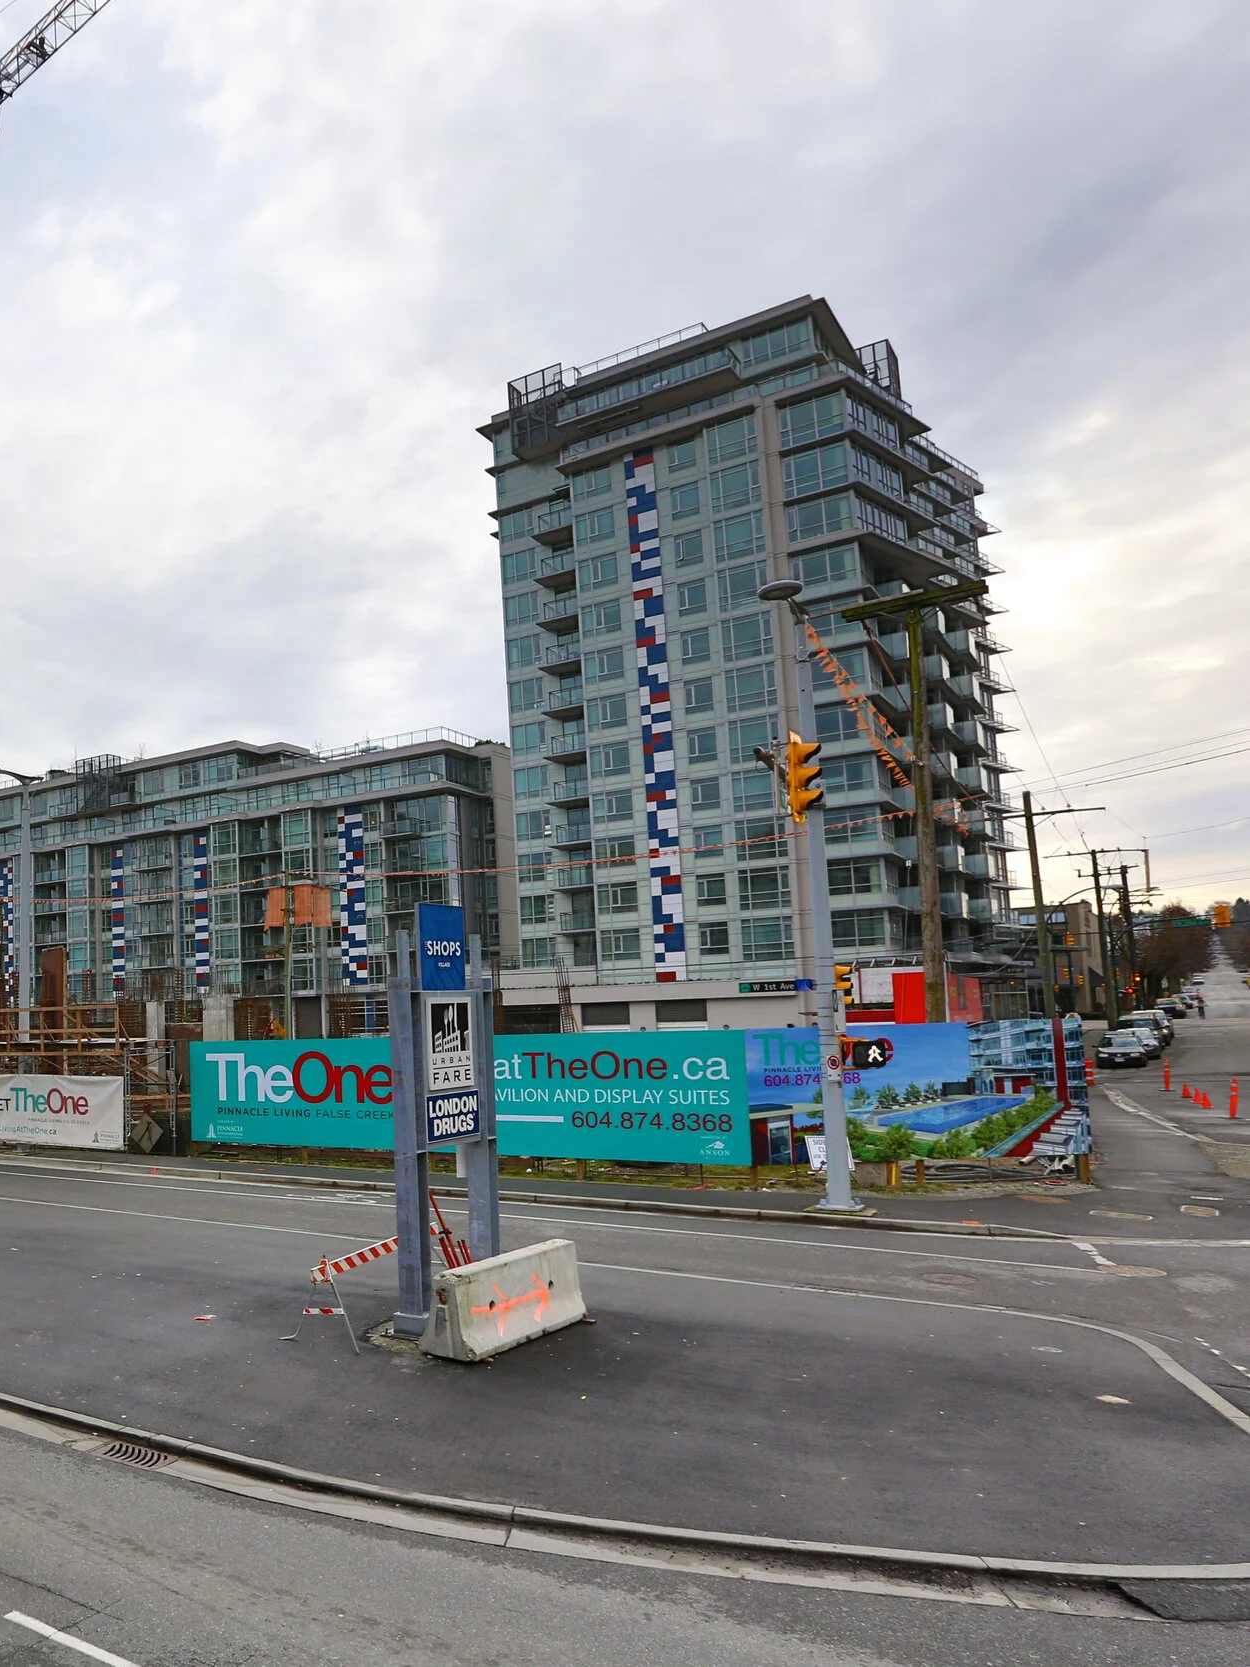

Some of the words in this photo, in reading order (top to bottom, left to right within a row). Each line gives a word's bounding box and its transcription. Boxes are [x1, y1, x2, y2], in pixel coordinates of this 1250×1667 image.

[427, 940, 461, 957] SHOPS
[752, 983, 760, 991] W
[764, 983, 776, 991] 1st
[780, 982, 795, 990] Ave
[432, 1055, 471, 1066] URBAN
[205, 1050, 393, 1104] TheOne
[433, 1069, 472, 1085] FARE
[10, 1086, 89, 1116] TheOne
[553, 1088, 590, 1104] AND
[594, 1089, 663, 1105] DISPLAY
[669, 1089, 730, 1106] SUITES
[217, 1107, 269, 1117] PINNACLE
[274, 1109, 311, 1118] LIVING
[316, 1110, 351, 1119] FALSE
[356, 1110, 394, 1120] CREEK
[429, 1095, 478, 1118] LONDON
[433, 1114, 475, 1137] DRUGS
[571, 1111, 733, 1133] 604.874.8368
